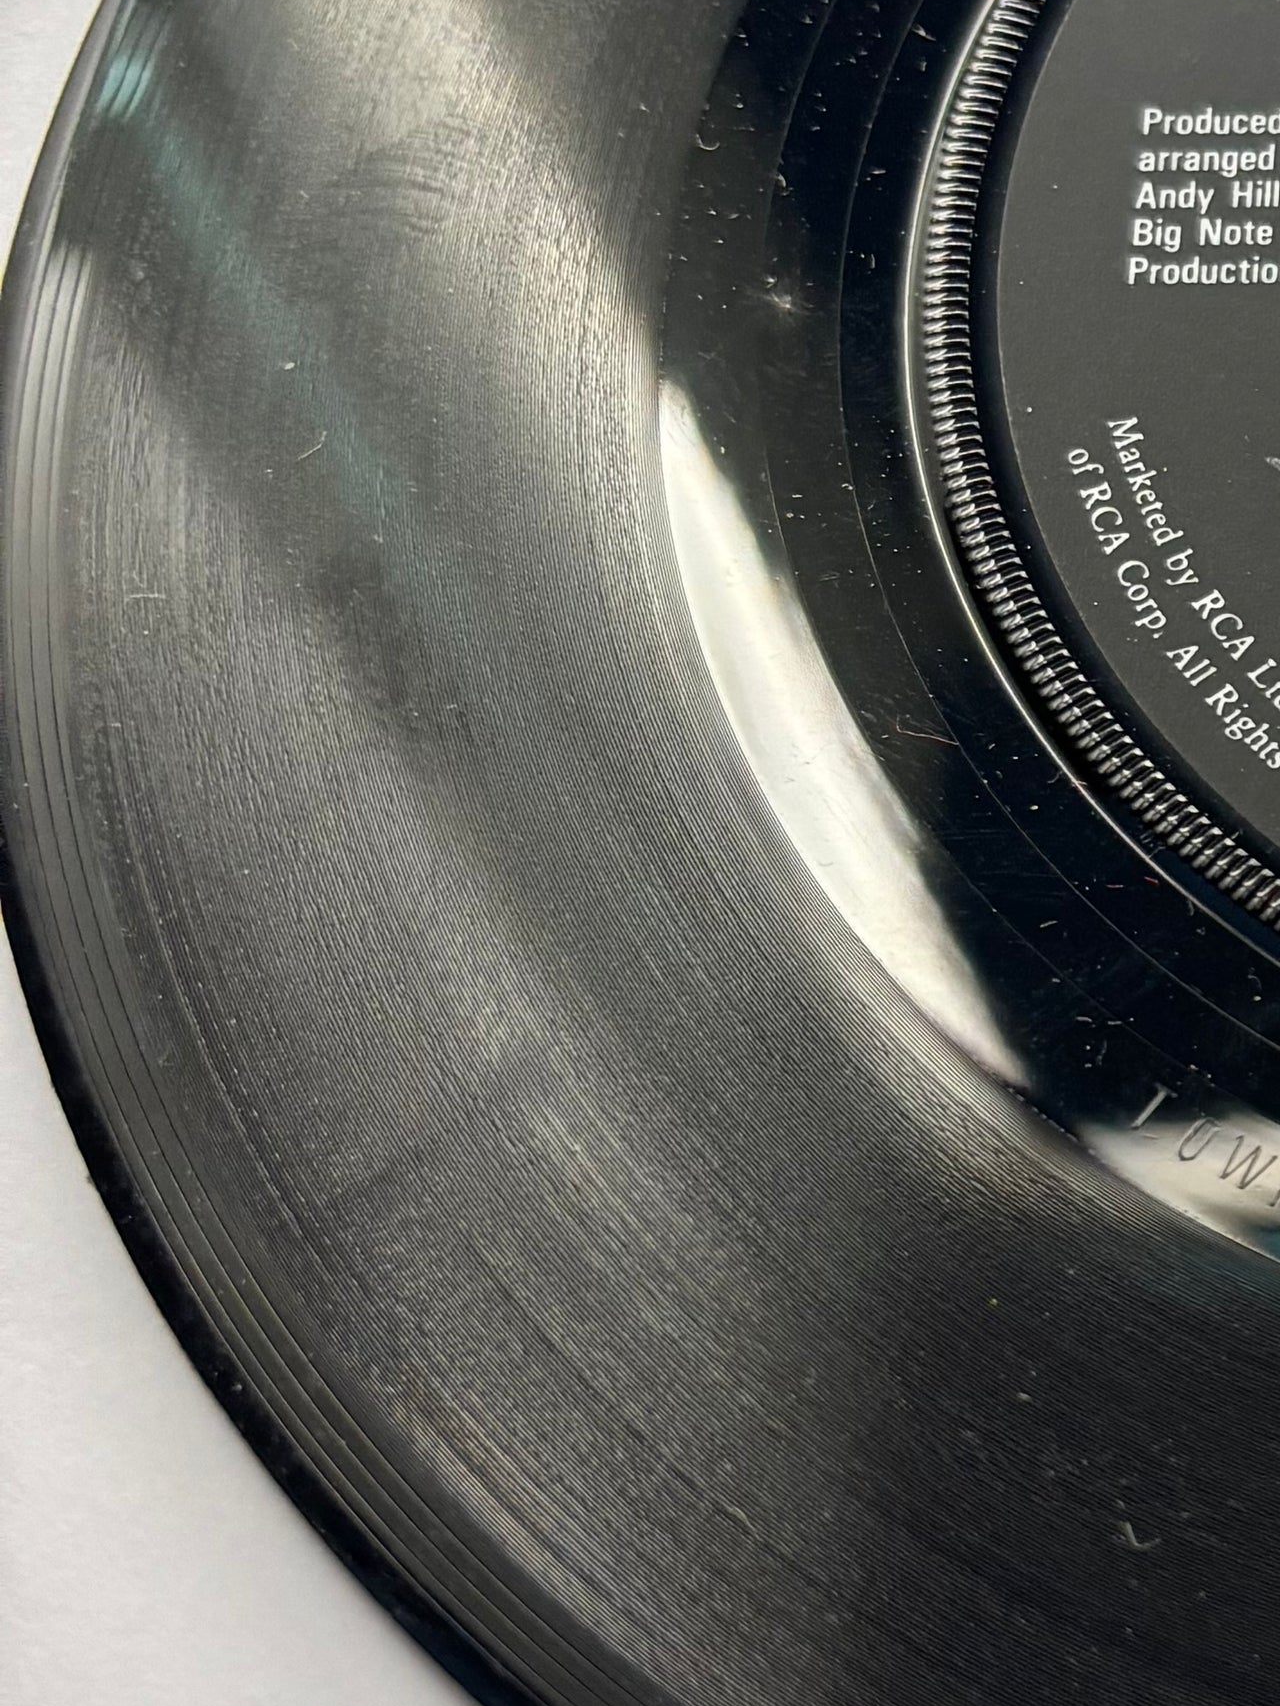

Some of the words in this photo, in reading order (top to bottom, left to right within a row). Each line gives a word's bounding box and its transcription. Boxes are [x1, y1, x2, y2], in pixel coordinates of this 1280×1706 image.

[1137, 144, 1276, 177] arranged
[1134, 181, 1215, 214] Andy
[1231, 180, 1280, 209] Hill
[1132, 218, 1182, 252] Big
[1199, 218, 1274, 246] Note
[1067, 447, 1105, 476] of
[1079, 481, 1131, 555] RCA
[1106, 416, 1184, 547] Marketed
[1165, 548, 1199, 586] by
[1191, 588, 1256, 661] RCA
[1165, 644, 1218, 687] All
